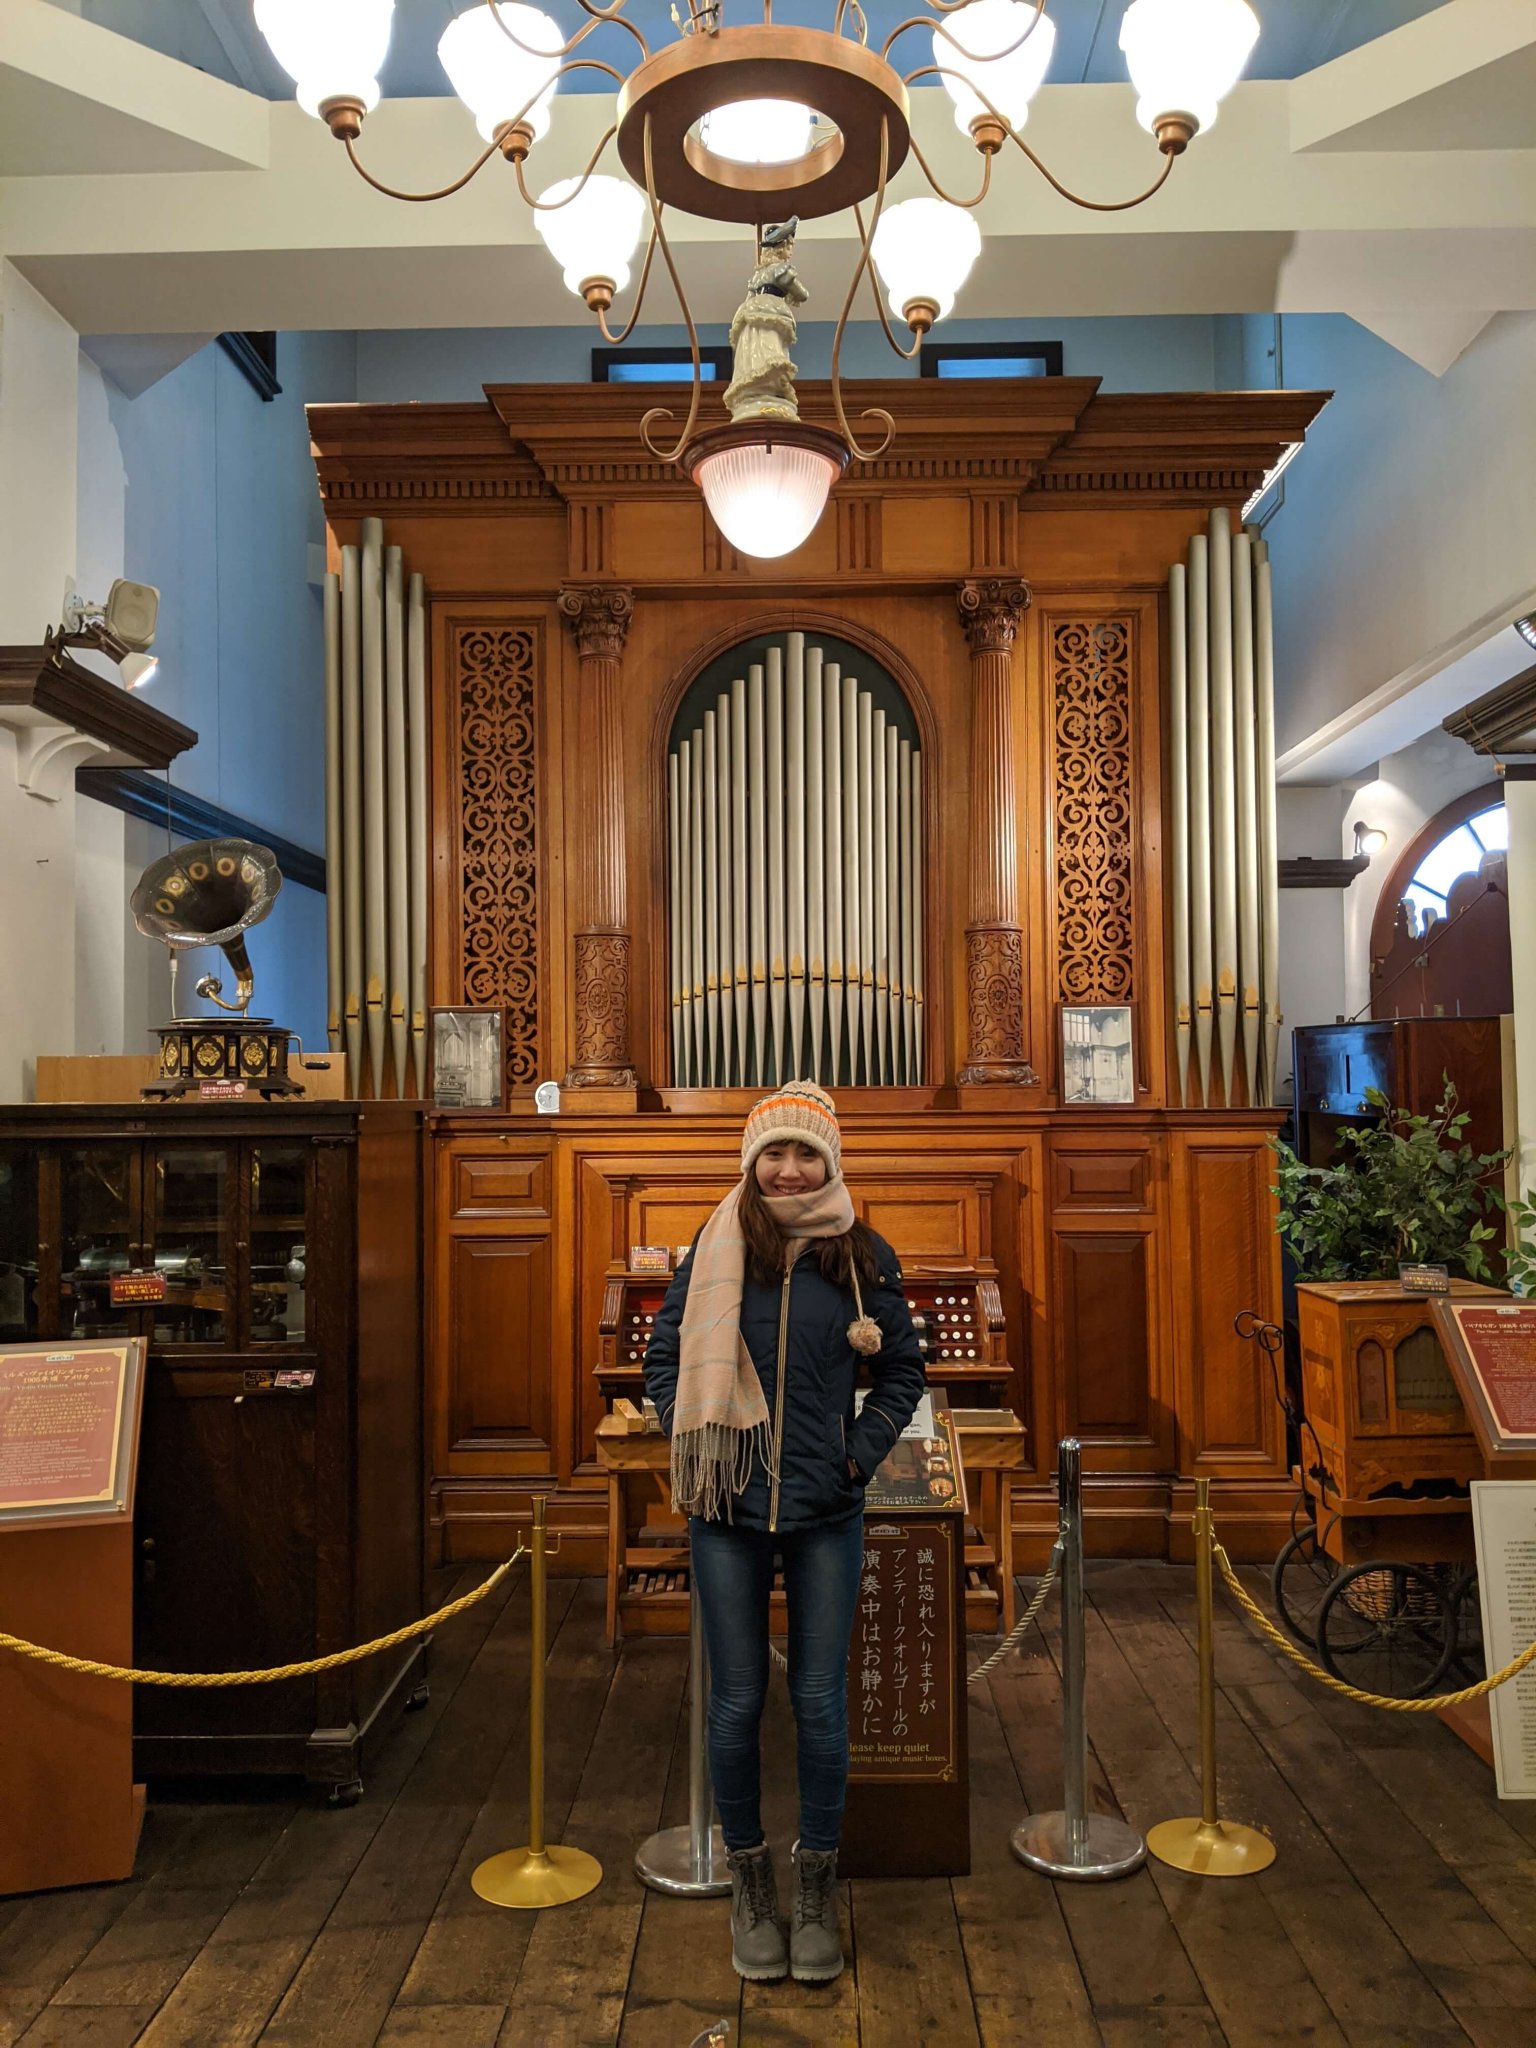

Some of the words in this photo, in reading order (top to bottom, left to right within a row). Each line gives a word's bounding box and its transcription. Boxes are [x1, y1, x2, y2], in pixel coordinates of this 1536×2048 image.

[861, 1549, 882, 1736] 演奏中はお静かに
[892, 1548, 908, 1736] アンティークオルゴールの
[917, 1548, 936, 1715] 誠に恐れ入りますが
[849, 1742, 874, 1752] lease
[877, 1742, 901, 1755] keep
[903, 1742, 930, 1755] quiet
[849, 1754, 872, 1763] laying
[874, 1755, 900, 1764] antique
